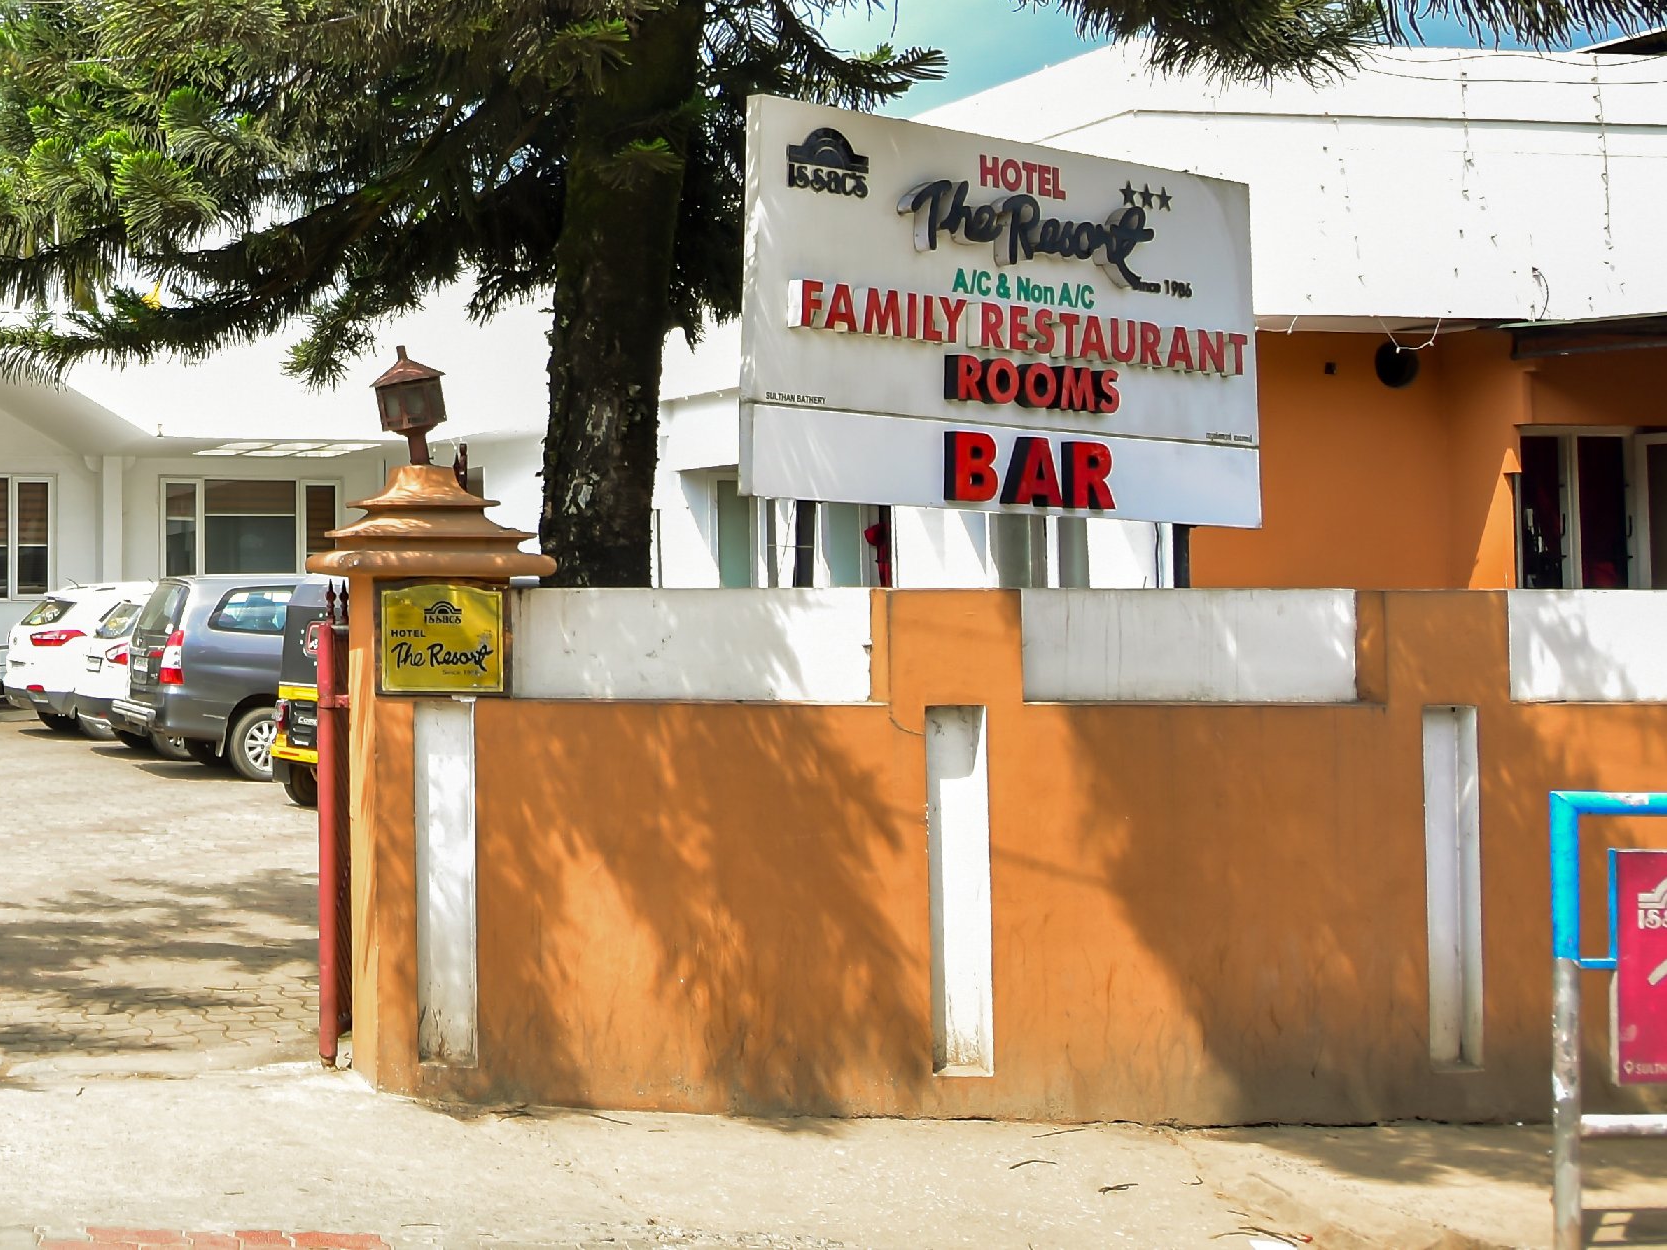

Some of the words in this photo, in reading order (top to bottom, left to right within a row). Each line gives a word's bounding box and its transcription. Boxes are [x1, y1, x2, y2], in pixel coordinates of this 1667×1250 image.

[979, 154, 1067, 201] HOTEL
[899, 179, 1003, 251] The
[995, 194, 1155, 289] Resort
[952, 268, 992, 297] A/C
[995, 274, 1012, 299] &
[1016, 276, 1055, 306] Non
[1059, 282, 1095, 310] A/C
[793, 279, 968, 345] FAMILY
[975, 302, 1248, 376] RESTAURANT
[765, 391, 795, 403] SULTHAN
[796, 394, 826, 405] BATHERY
[946, 354, 1121, 414] ROOMS
[944, 430, 1117, 510] BAR
[391, 629, 426, 638] HOTEL
[391, 642, 426, 668] The
[427, 642, 494, 672] Resort
